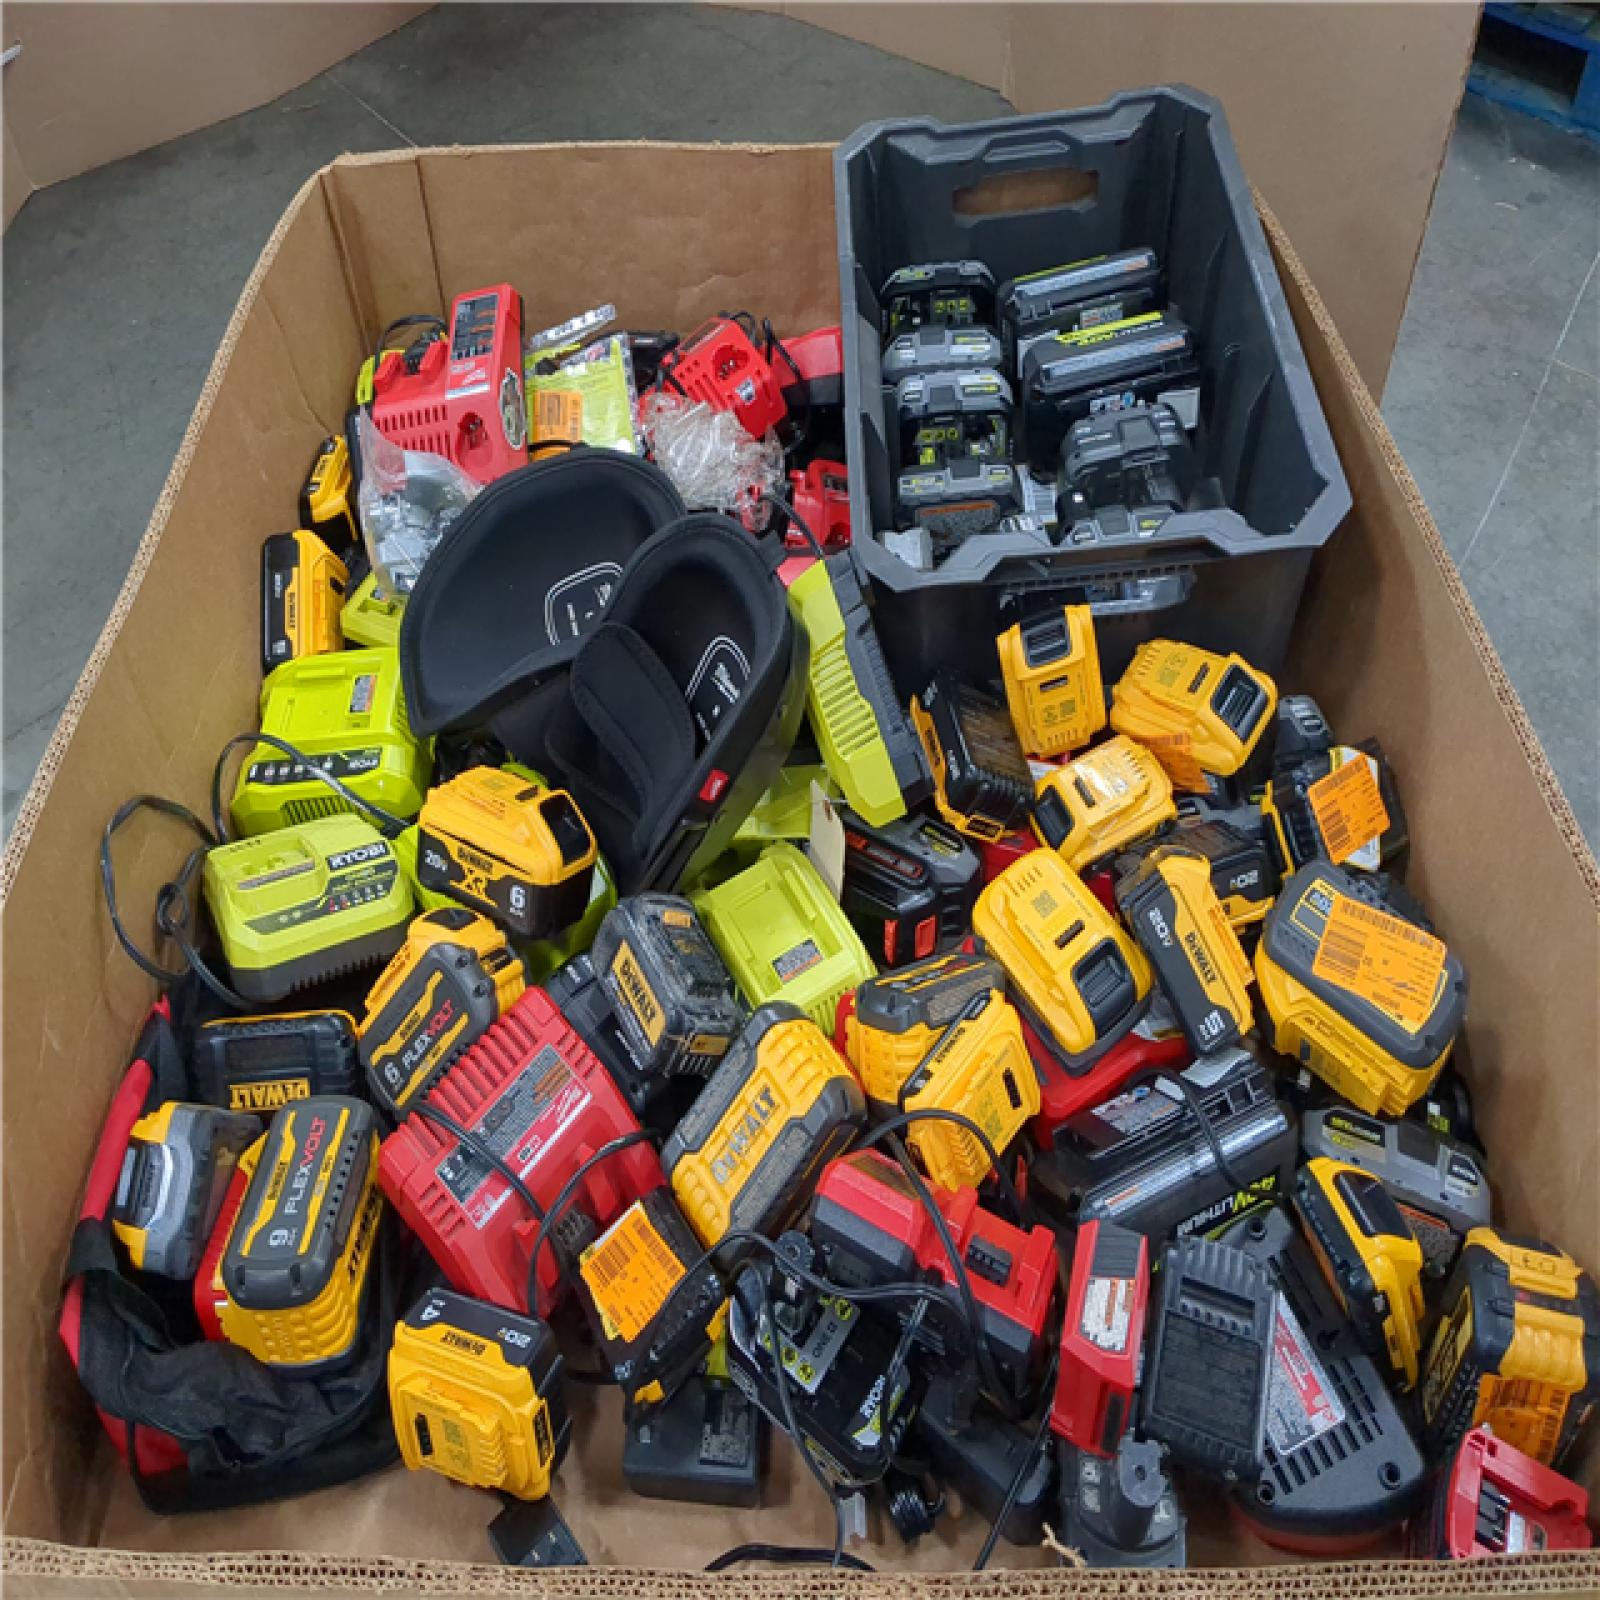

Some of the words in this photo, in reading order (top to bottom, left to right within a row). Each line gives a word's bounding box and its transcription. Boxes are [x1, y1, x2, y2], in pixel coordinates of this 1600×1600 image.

[329, 843, 388, 870] RYOBI
[620, 958, 656, 1022] DEWALT
[1184, 932, 1218, 985] DEWALT
[402, 999, 455, 1071] FLEXVOLT
[284, 1115, 327, 1214] FLEXVOLT
[710, 1084, 779, 1186] DEWALT
